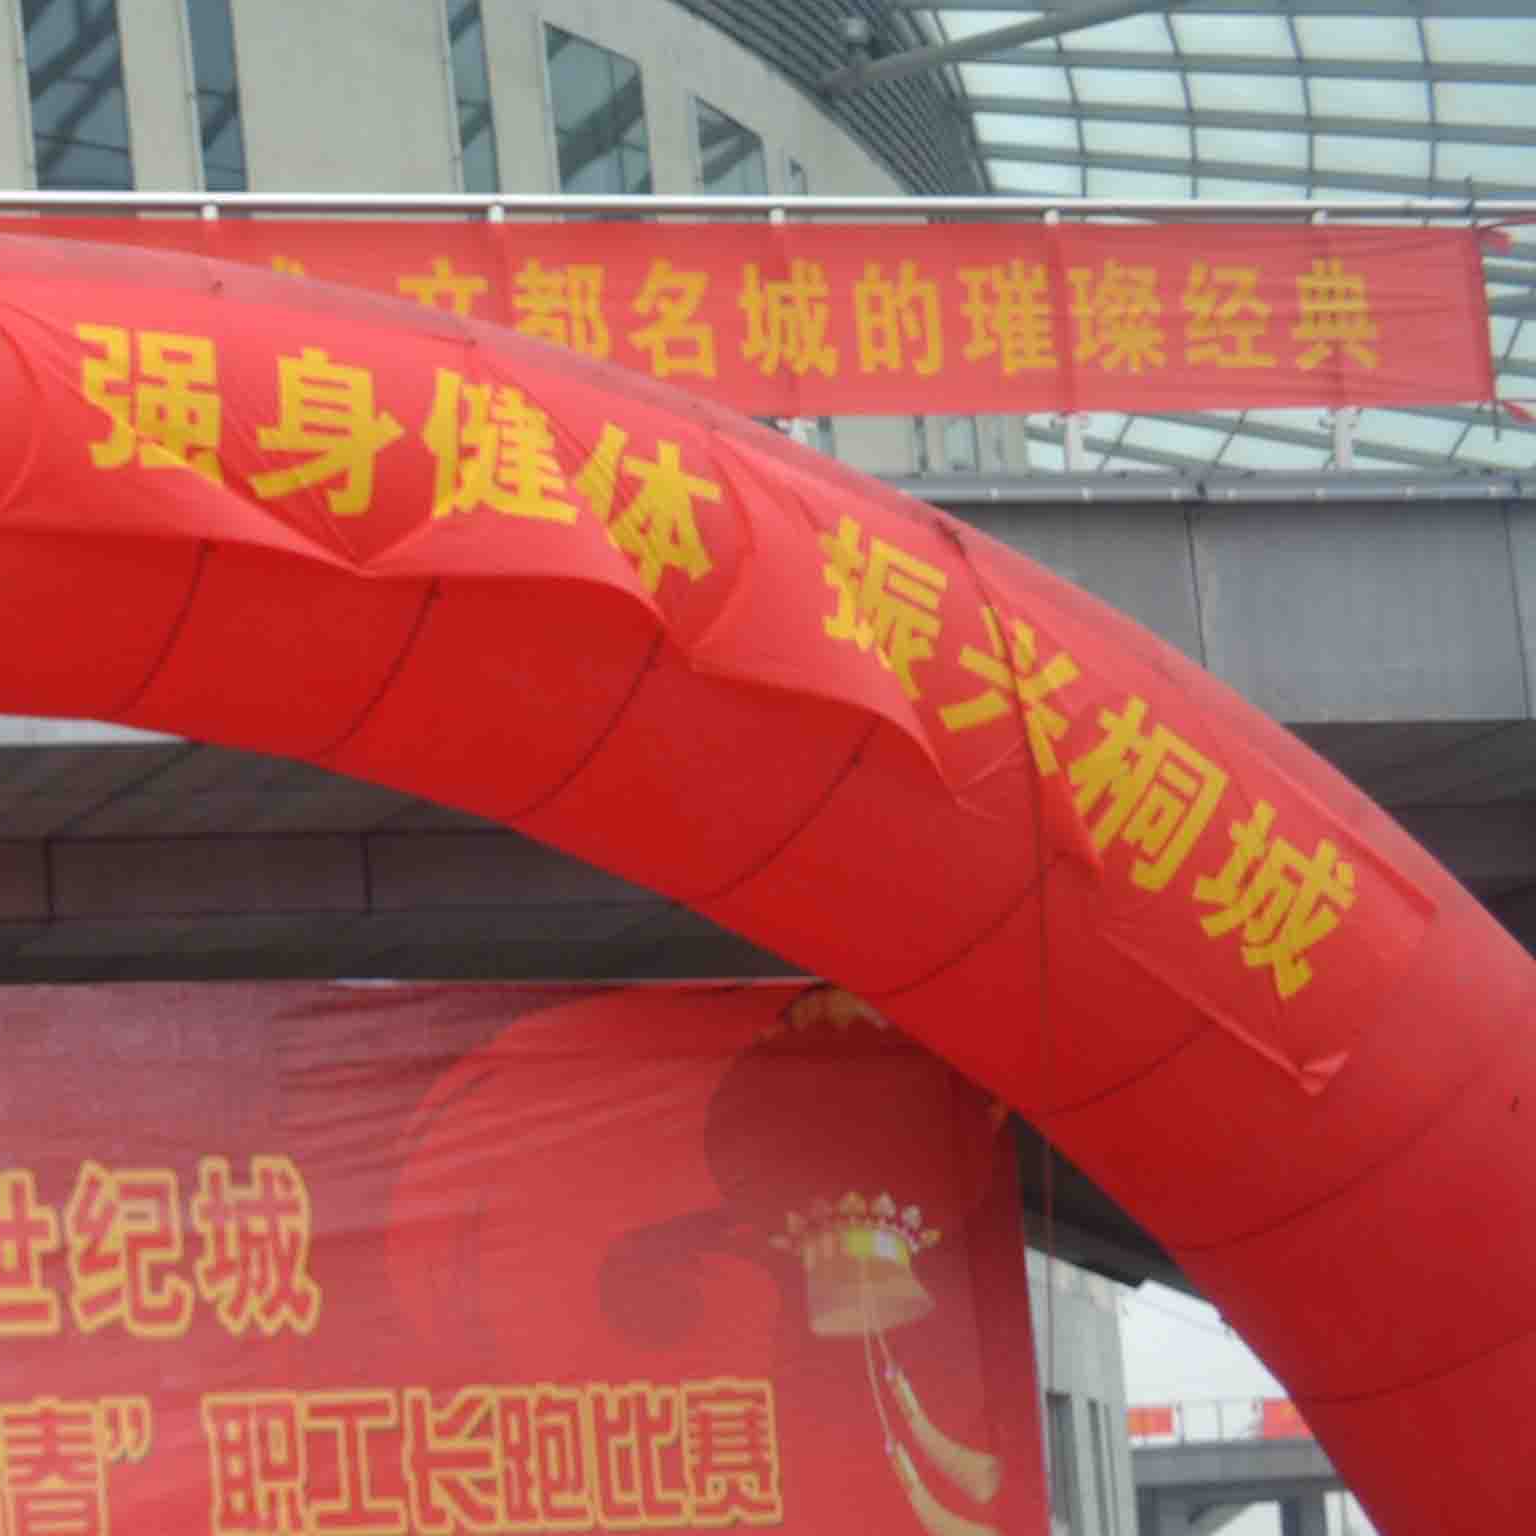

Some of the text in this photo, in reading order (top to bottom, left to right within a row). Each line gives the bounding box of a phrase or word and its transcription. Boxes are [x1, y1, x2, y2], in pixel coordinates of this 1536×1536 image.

[271, 255, 1379, 378] 文都名城的璀璨经典
[78, 321, 722, 590] 强身健体
[818, 515, 1358, 998] 振兴桐城
